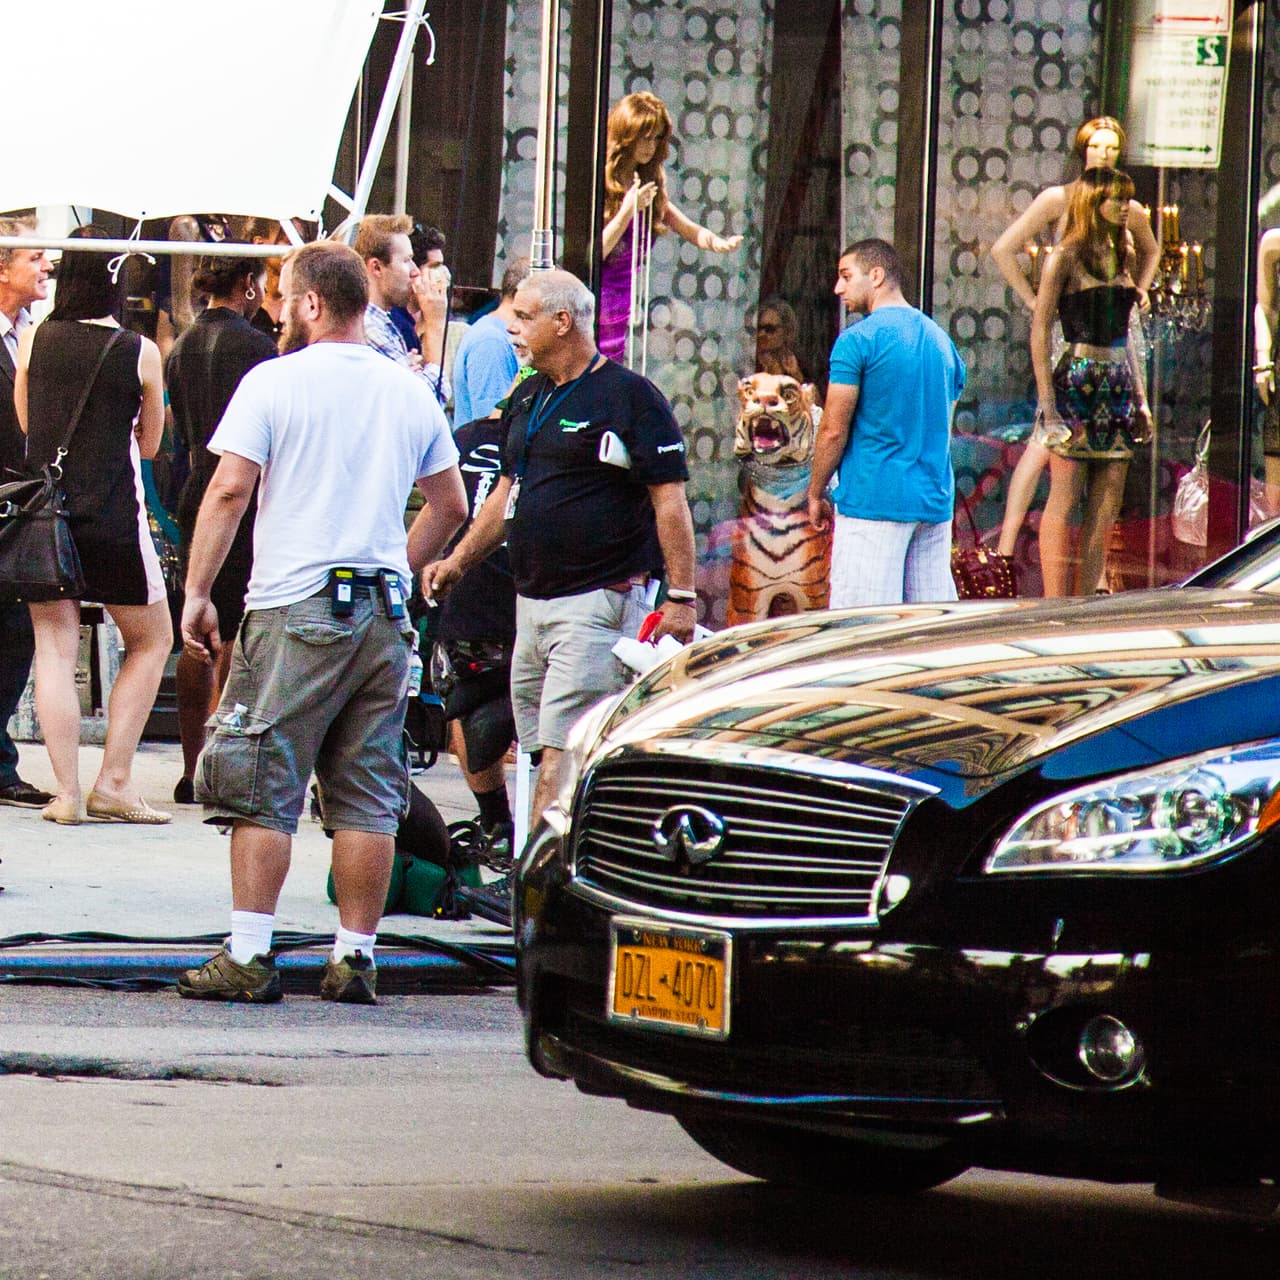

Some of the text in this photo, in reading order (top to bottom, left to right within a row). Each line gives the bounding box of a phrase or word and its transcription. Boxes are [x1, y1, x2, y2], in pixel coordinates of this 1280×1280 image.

[642, 931, 701, 954] NEW YORK
[672, 959, 717, 1010] 4070
[677, 1010, 709, 1027] STAT
